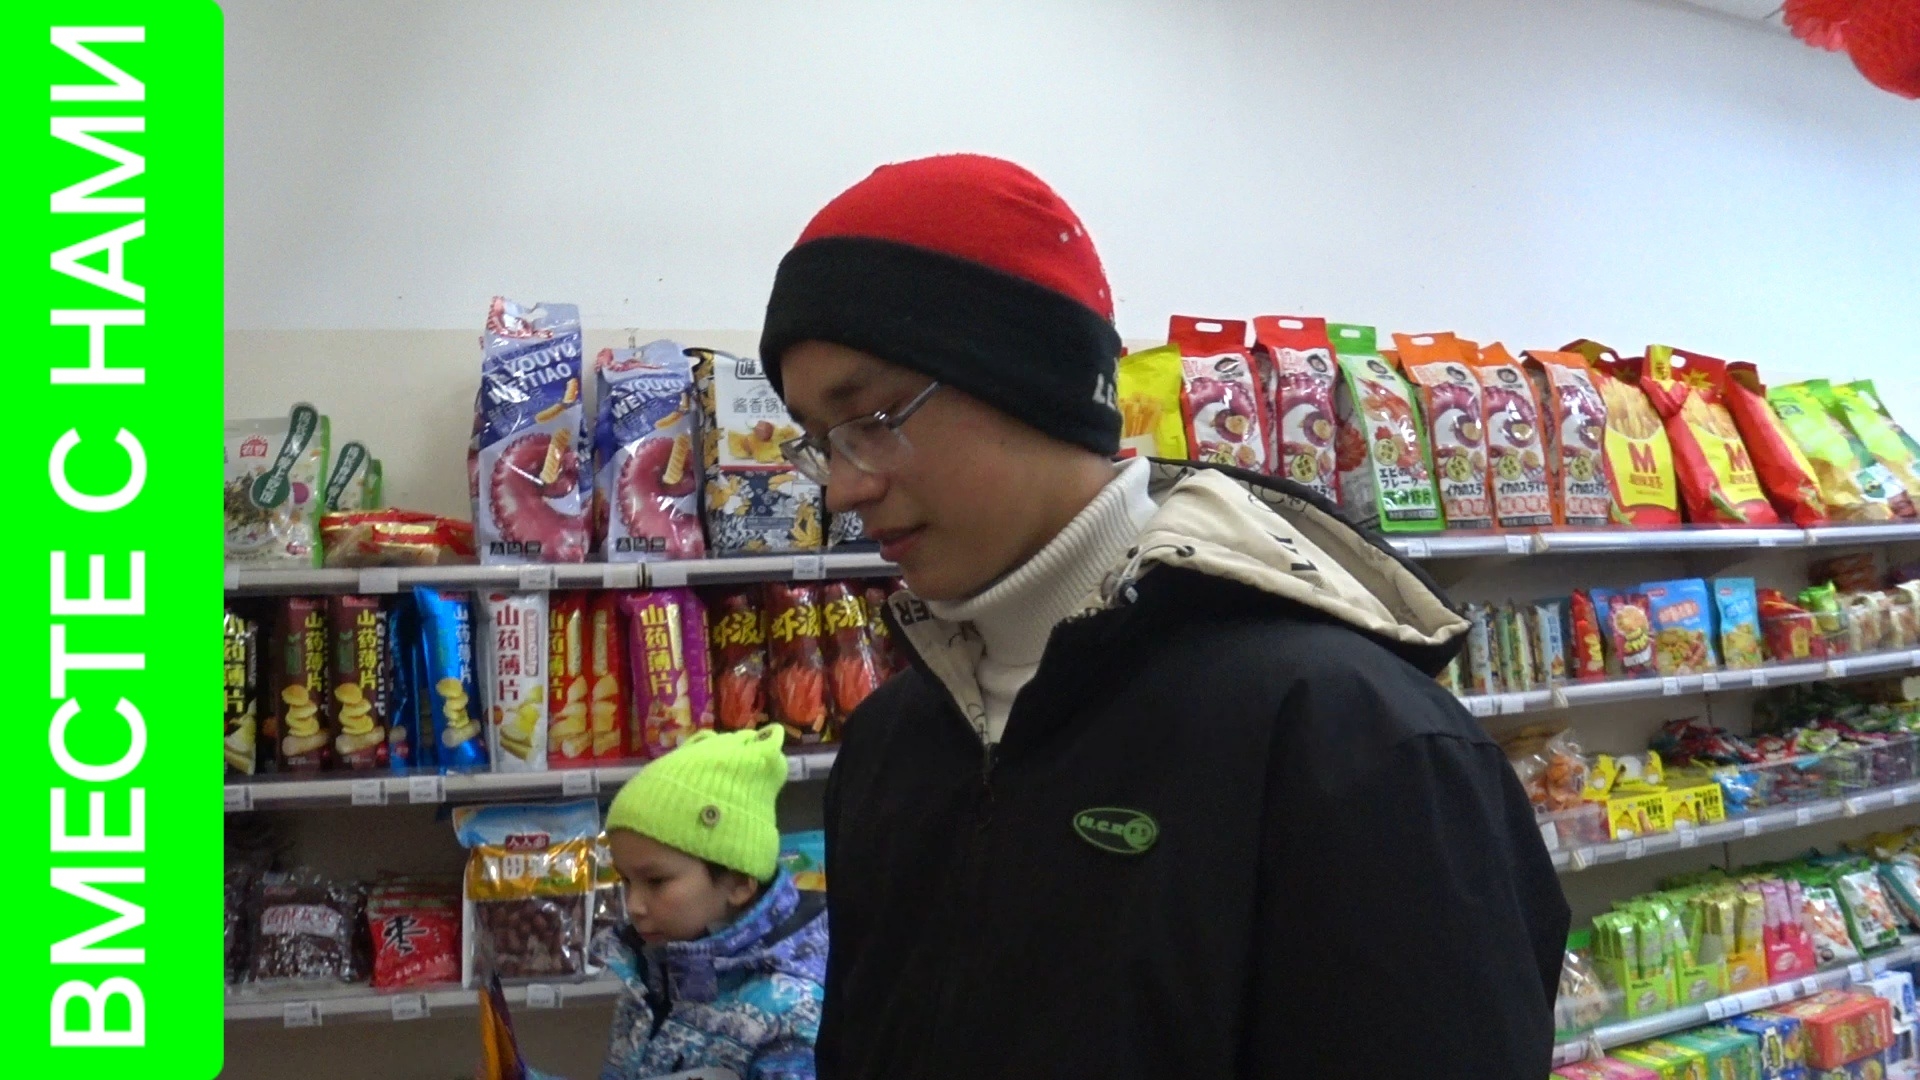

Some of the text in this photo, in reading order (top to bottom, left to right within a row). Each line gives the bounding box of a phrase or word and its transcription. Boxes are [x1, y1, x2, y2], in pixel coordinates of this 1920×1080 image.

[503, 342, 577, 376] YOUYU
[1628, 441, 1657, 474] M
[357, 609, 377, 691] 山药薄片
[496, 604, 520, 701] 山药薄片
[640, 603, 673, 696] 山药薄片
